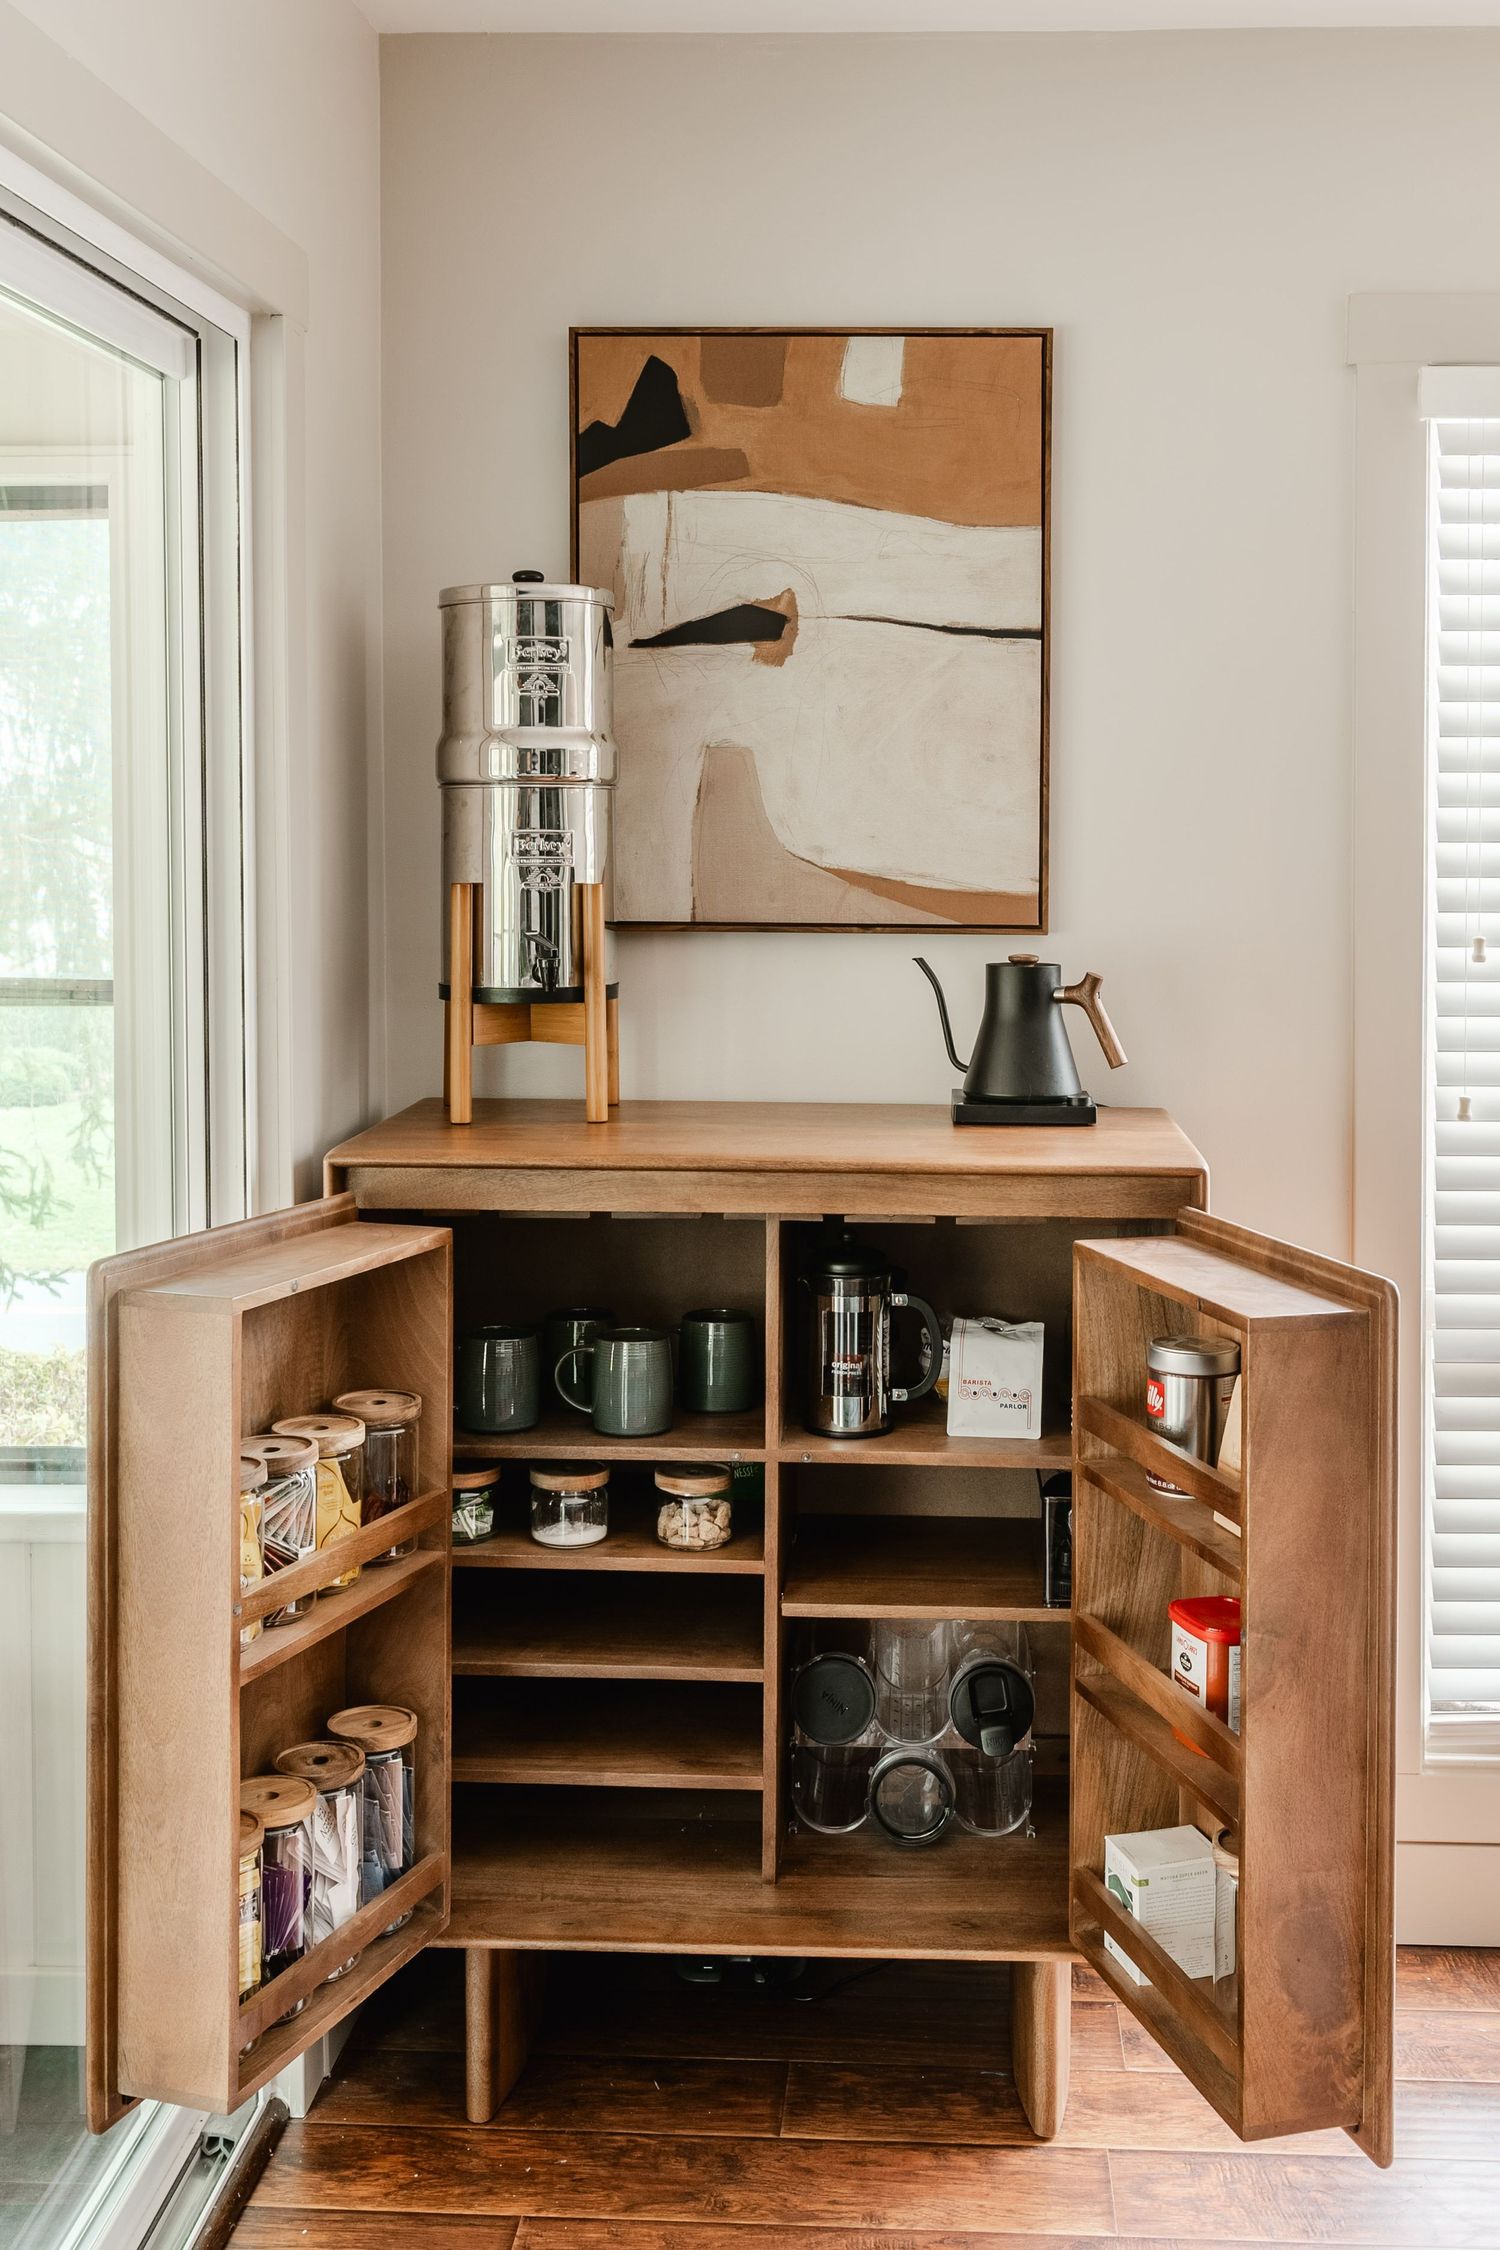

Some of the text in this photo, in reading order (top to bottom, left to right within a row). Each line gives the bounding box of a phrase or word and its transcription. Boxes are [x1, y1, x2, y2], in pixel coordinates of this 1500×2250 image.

[511, 644, 561, 662] Berkey
[513, 837, 565, 854] Berkey
[831, 1361, 863, 1370] original
